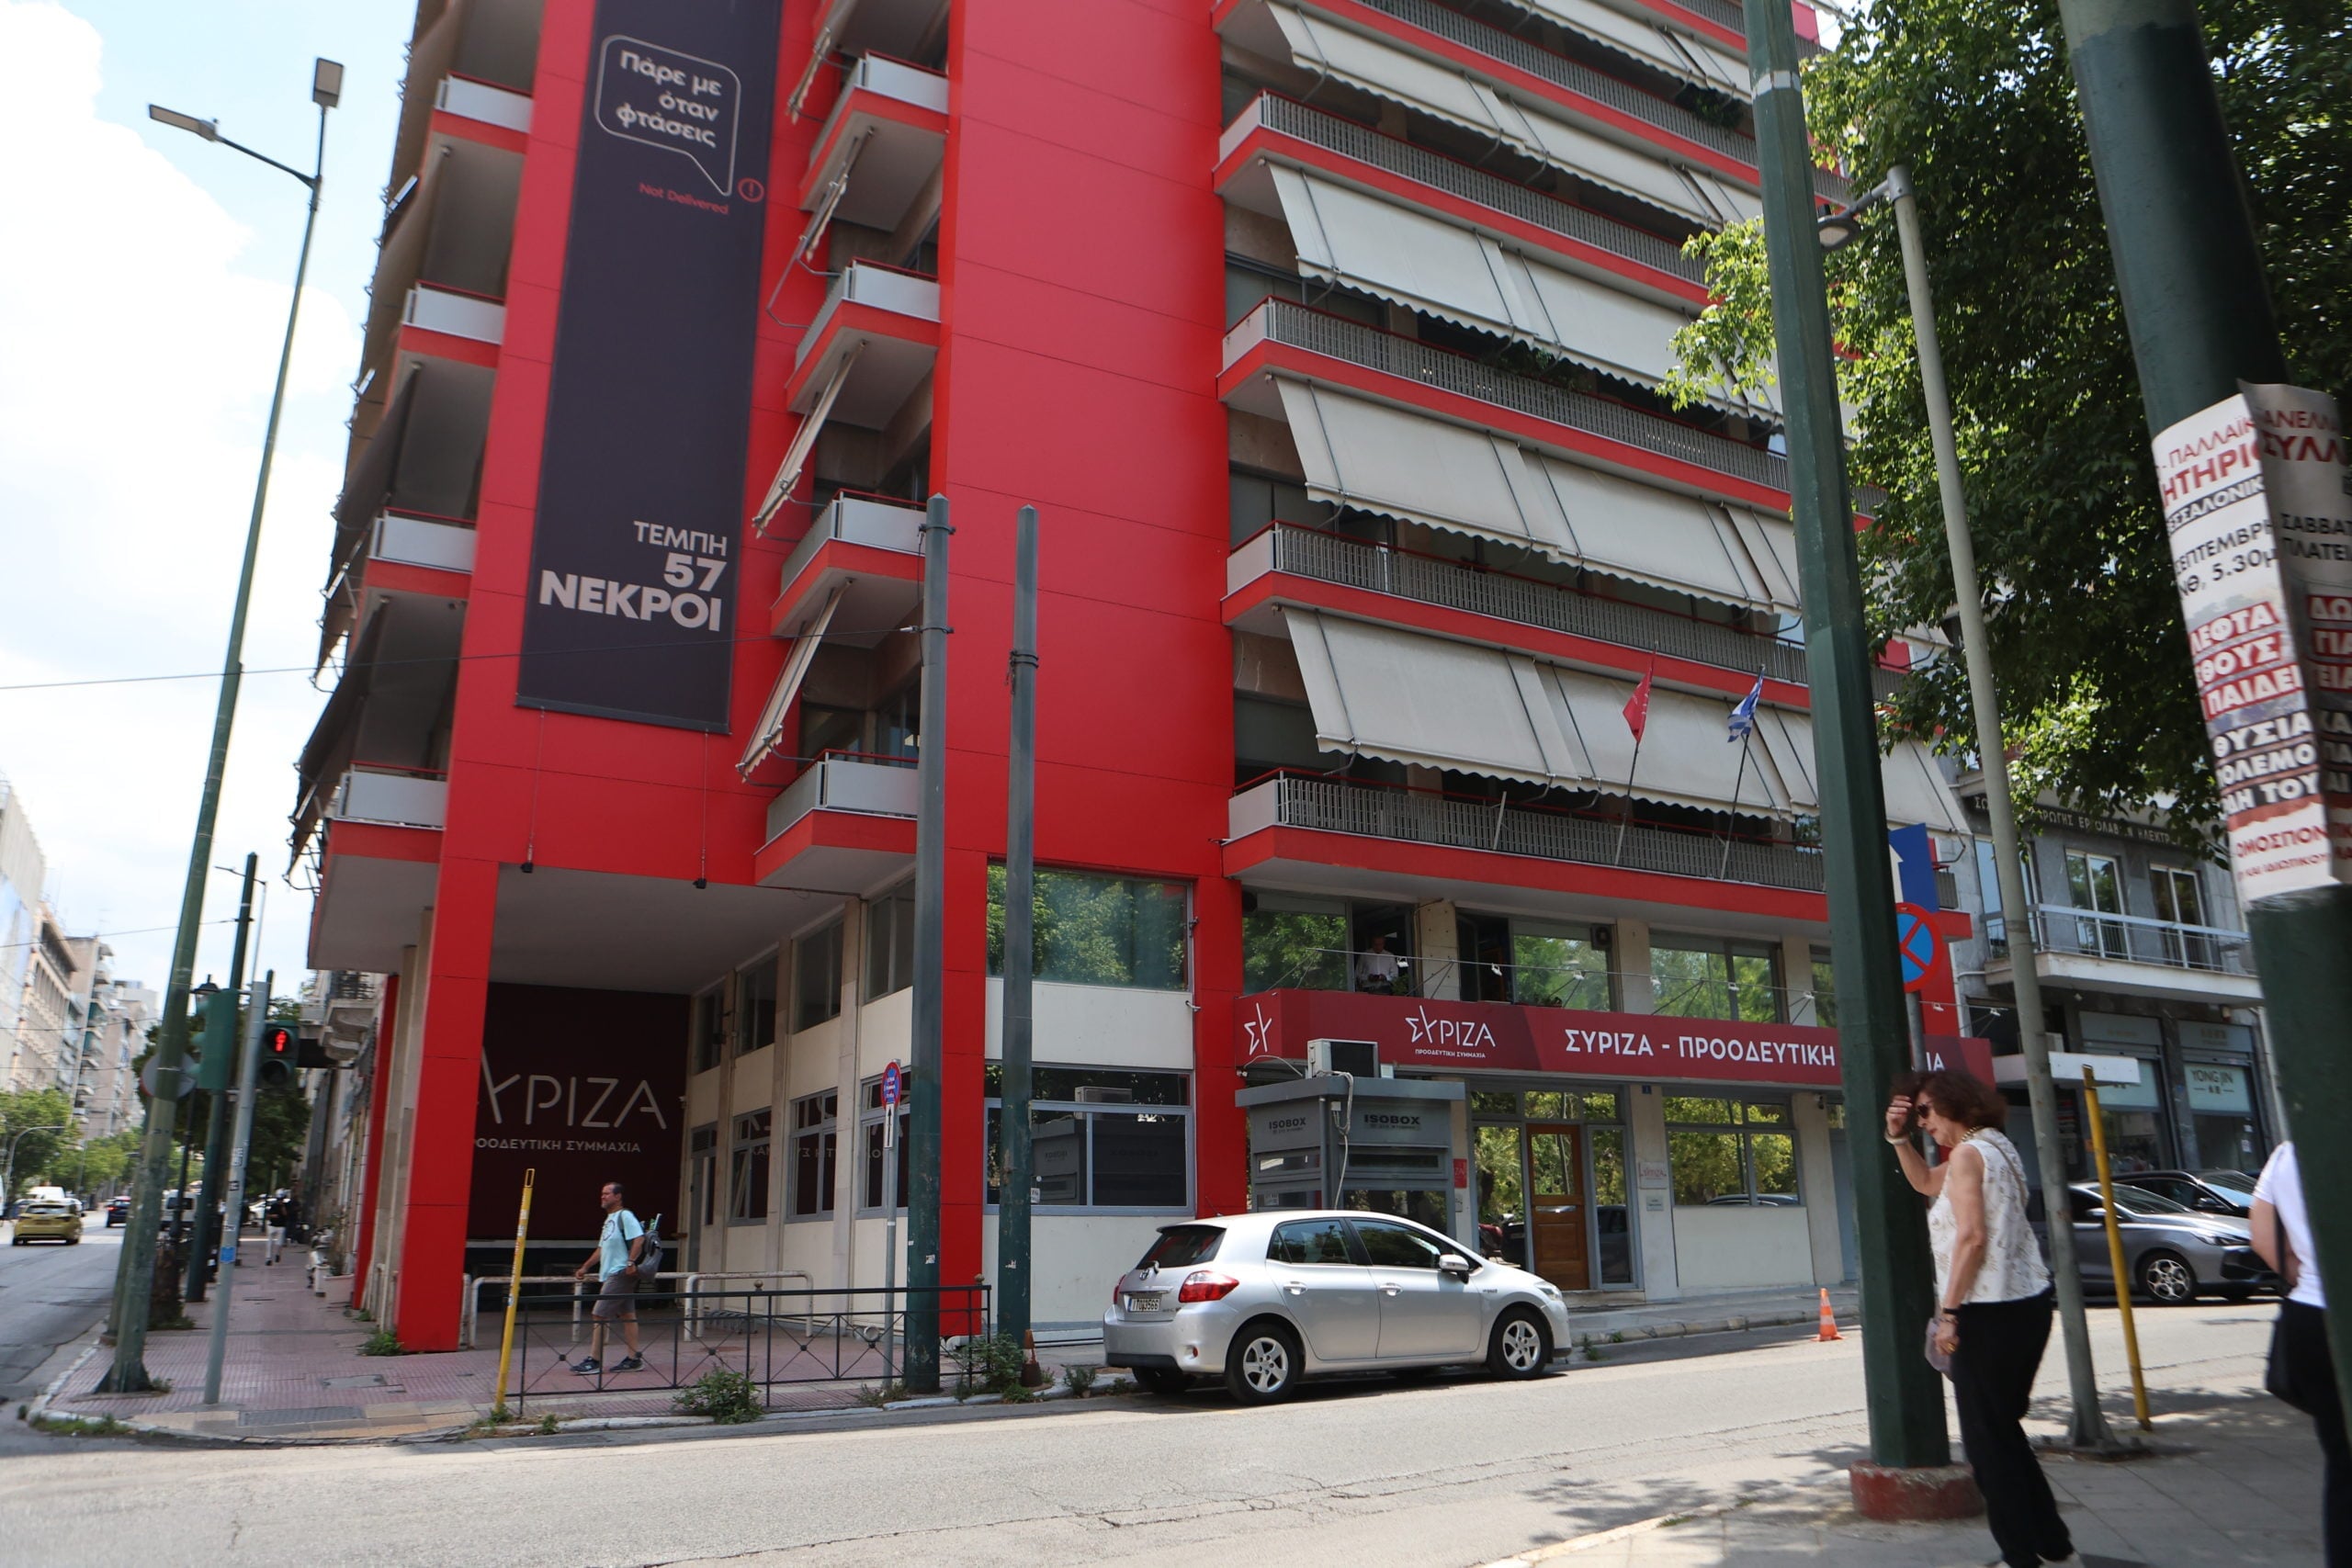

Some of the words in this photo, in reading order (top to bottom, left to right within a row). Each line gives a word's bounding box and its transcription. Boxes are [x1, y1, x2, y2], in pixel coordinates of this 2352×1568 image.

[620, 50, 685, 85] Πάρε
[693, 74, 722, 96] με
[616, 102, 716, 148] φτάσεις
[659, 91, 719, 122] όταν
[639, 183, 664, 201] Not
[668, 186, 729, 215] Delivered
[633, 520, 728, 556] ΤΕΜΠΗ
[663, 552, 728, 592] 57
[539, 569, 722, 632] ΝΕΚΡΟΙ
[2213, 712, 2313, 758] ΘΥΣΙΑ
[1405, 1005, 1497, 1047] ΣΥΡΙΖΑ
[1415, 1048, 1455, 1056] ΠΡΟΟΔΕΥΤΙΚΗ
[1564, 1028, 1654, 1056] ΣΥΡΙΖΑ
[1679, 1035, 1836, 1067] ΠΡΟΟΔΕΥΤΙΚΗ
[481, 1046, 667, 1130] ΥΡΙΖΑ
[1269, 1117, 1306, 1129] ISOBOX
[1363, 1113, 1420, 1124] ISOBOX
[476, 1137, 561, 1151] ΟΟΔΕΥΤΙΚΗ
[566, 1140, 641, 1153] ΣΥΜΜΑΧΙΑ
